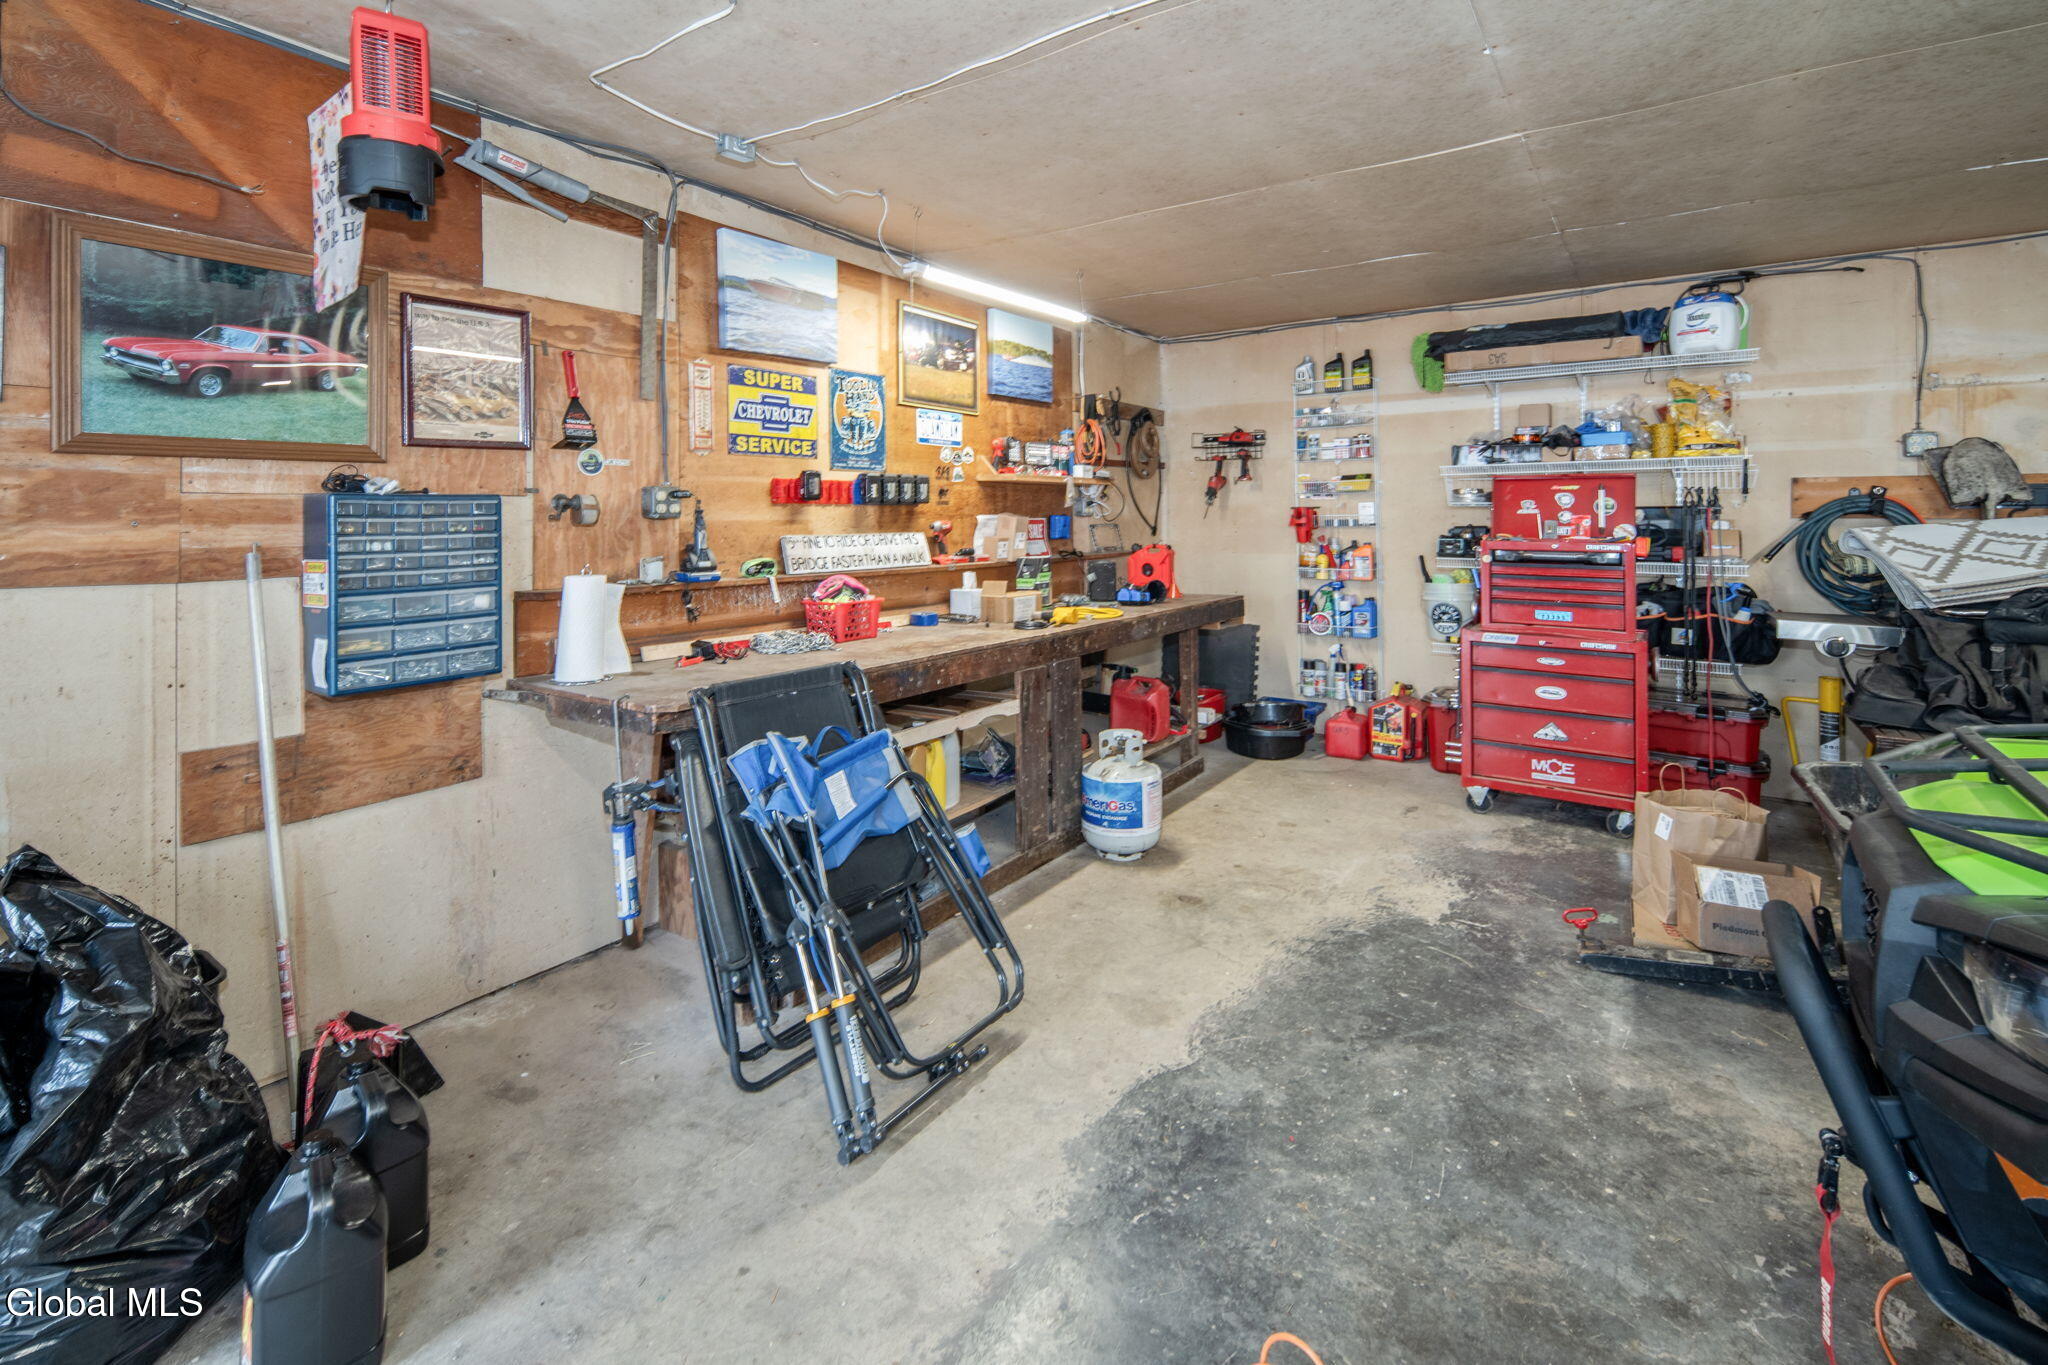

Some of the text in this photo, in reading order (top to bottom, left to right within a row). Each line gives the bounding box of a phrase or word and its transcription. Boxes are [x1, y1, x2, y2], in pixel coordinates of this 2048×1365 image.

[743, 369, 804, 392] SUPER
[737, 402, 811, 424] CHEVROLET
[735, 436, 812, 456] SERVICE
[1028, 524, 1044, 539] SALE
[791, 556, 829, 571] BRIDGE
[831, 554, 864, 569] FASTER
[864, 553, 890, 567] THAN
[902, 551, 926, 564] WALK
[1712, 922, 1760, 936] Piedmont
